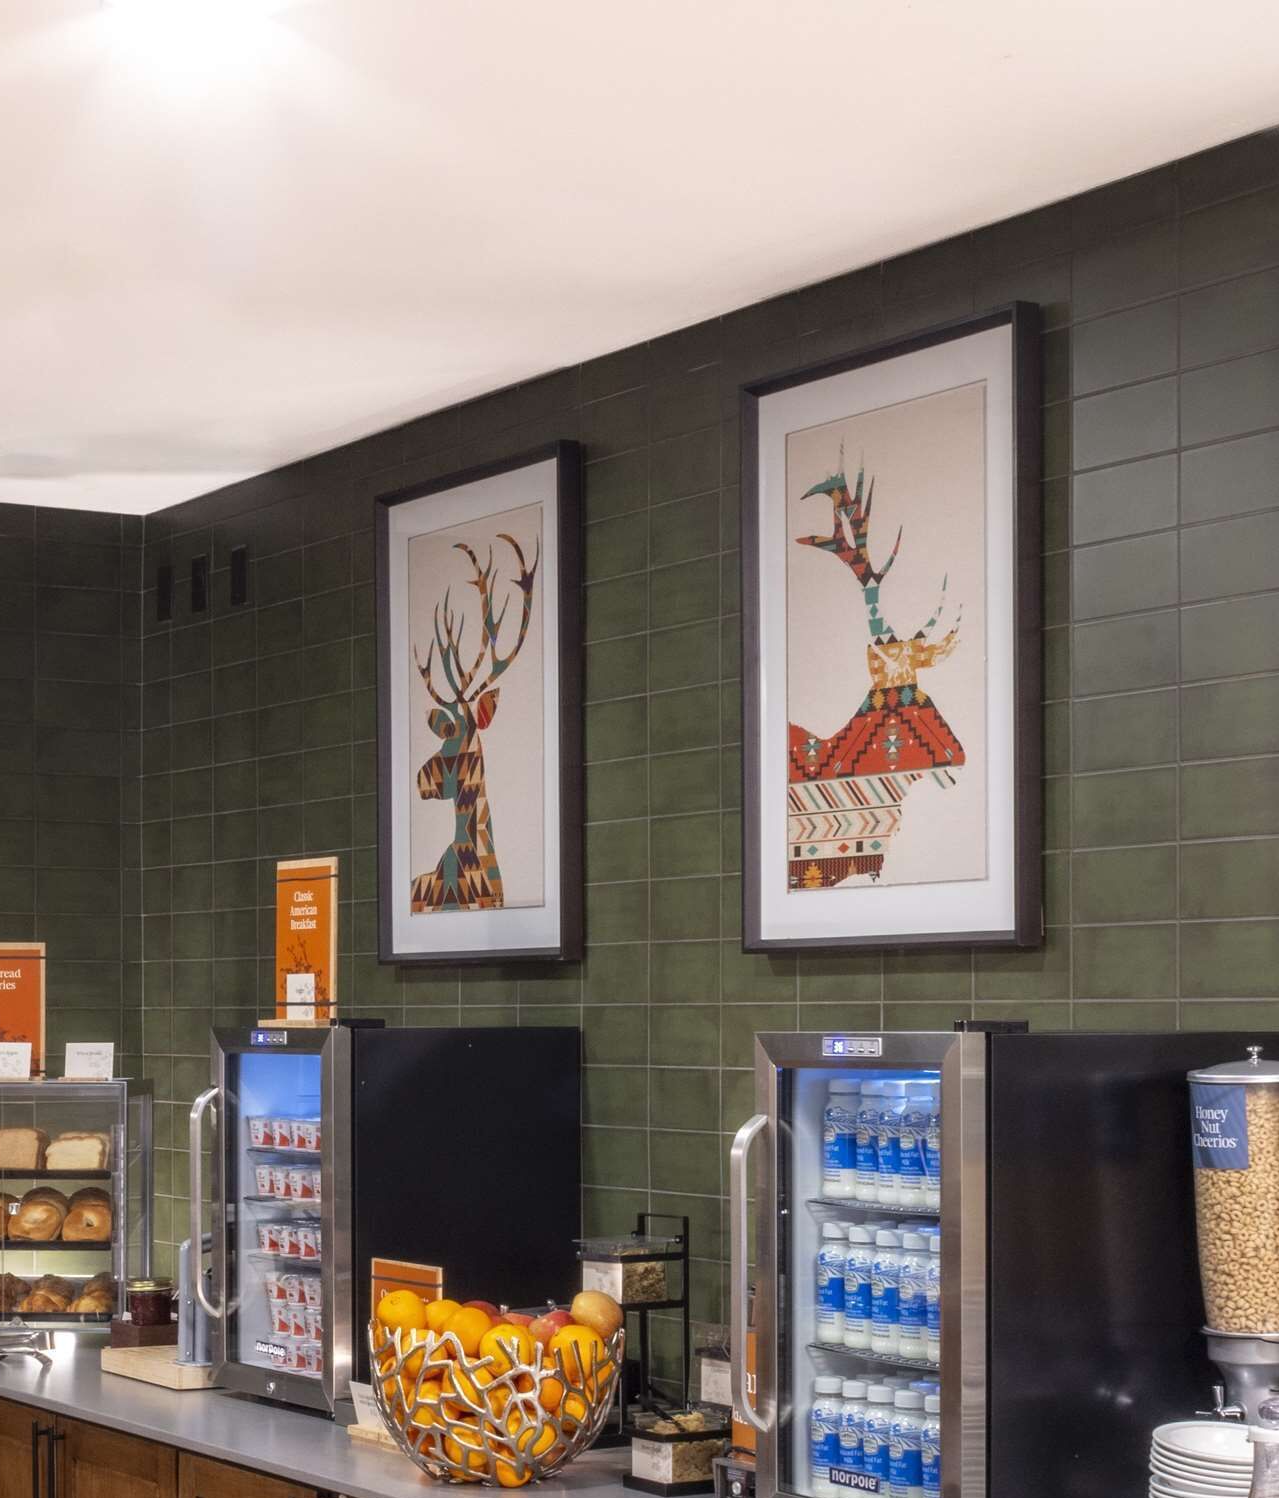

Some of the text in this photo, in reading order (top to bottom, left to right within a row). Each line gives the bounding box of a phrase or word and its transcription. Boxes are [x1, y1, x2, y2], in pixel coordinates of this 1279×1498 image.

[294, 890, 314, 902] Classic
[290, 905, 318, 916] American
[290, 919, 317, 930] Breakfast
[1195, 1105, 1229, 1123] Honey
[1201, 1120, 1221, 1134] Nut
[1193, 1133, 1237, 1149] Cheerios
[256, 1342, 285, 1357] norpole
[831, 1469, 877, 1490] norpole
